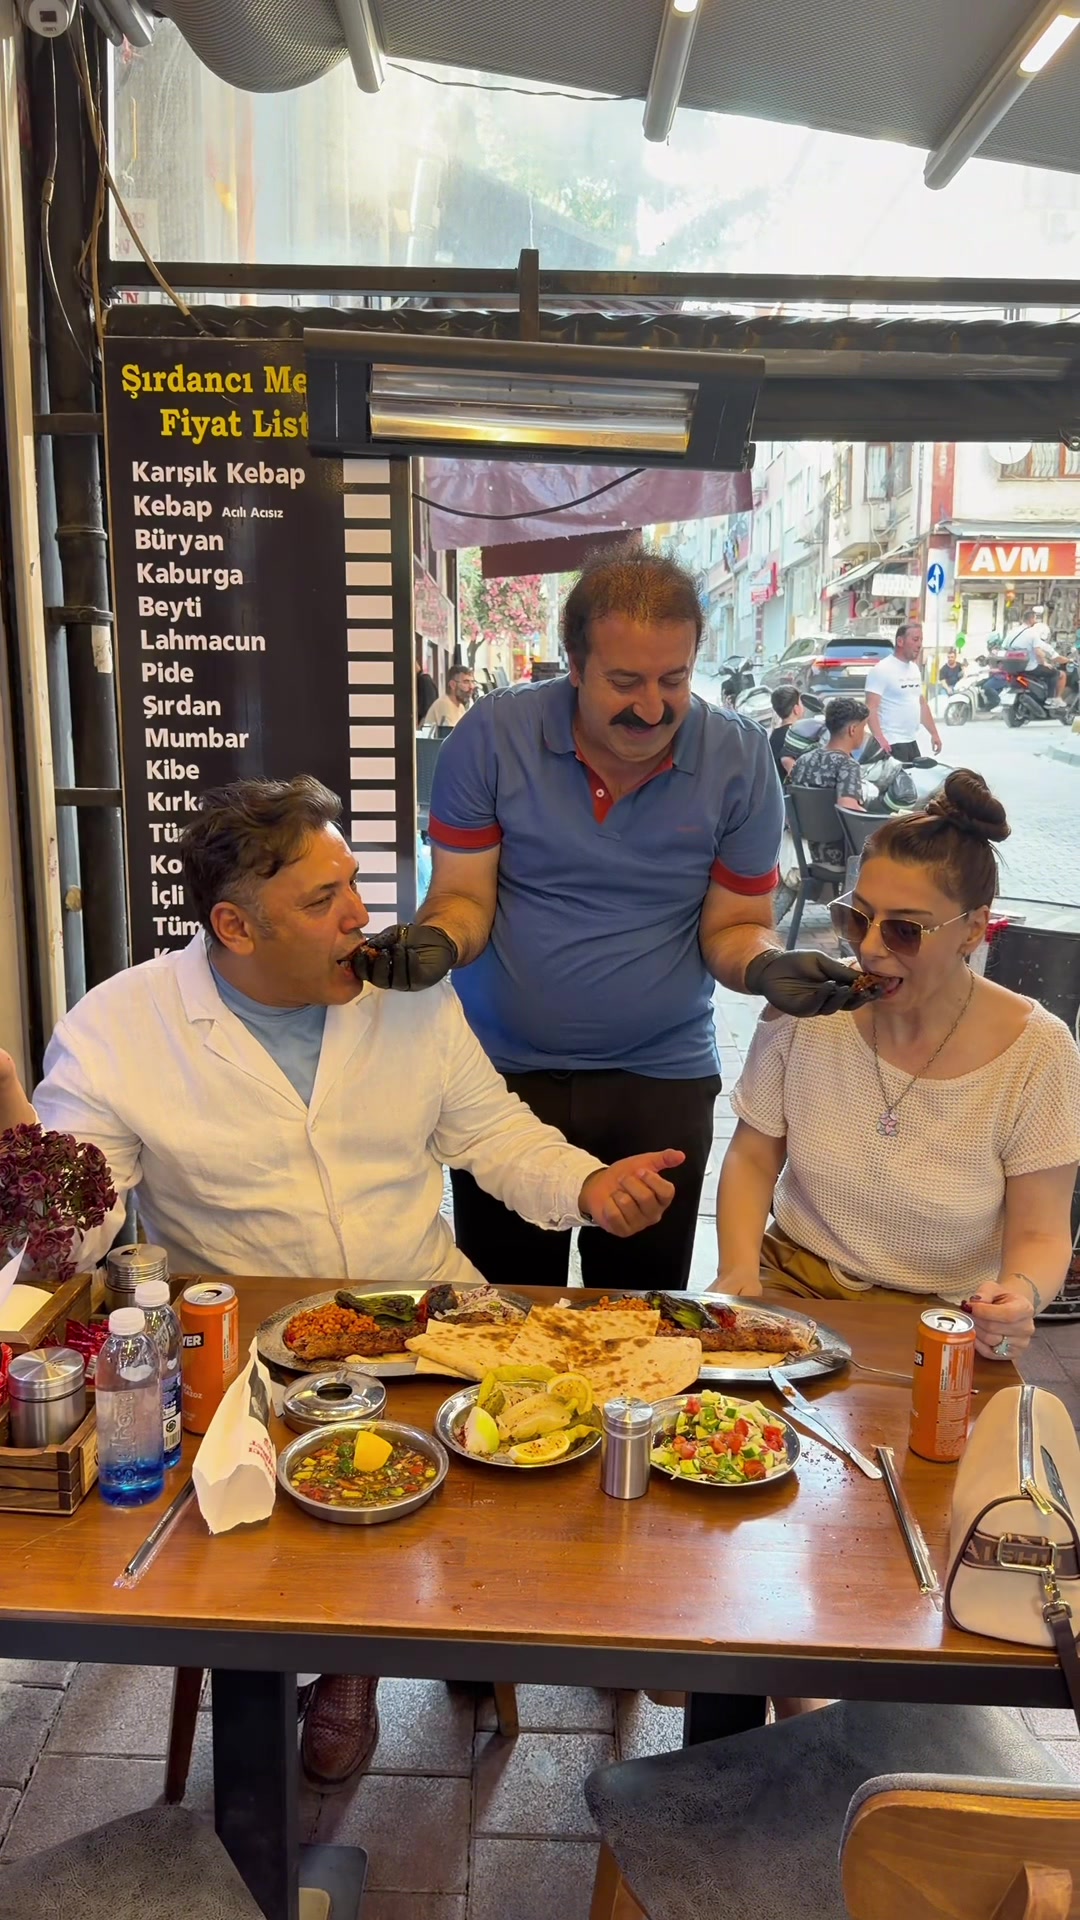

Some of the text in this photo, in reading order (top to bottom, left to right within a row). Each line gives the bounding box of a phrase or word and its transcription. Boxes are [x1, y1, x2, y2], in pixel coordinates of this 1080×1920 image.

[121, 363, 253, 399] Şırdancı
[160, 408, 243, 445] Fiyat
[132, 460, 306, 490] Karışık Kebap
[133, 493, 284, 522] Kebap Acılı Acısız
[135, 528, 224, 555] Büryan
[970, 546, 1050, 572] AVM
[136, 562, 244, 590] Kaburga
[138, 595, 202, 622] Beyti
[140, 628, 266, 652] Lahmacun
[141, 661, 194, 683] Pide
[143, 693, 221, 719] Şırdan
[144, 726, 250, 748] Mumbar
[146, 758, 200, 780] Kibe
[147, 790, 203, 812] Kırk
[151, 880, 185, 909] İçli
